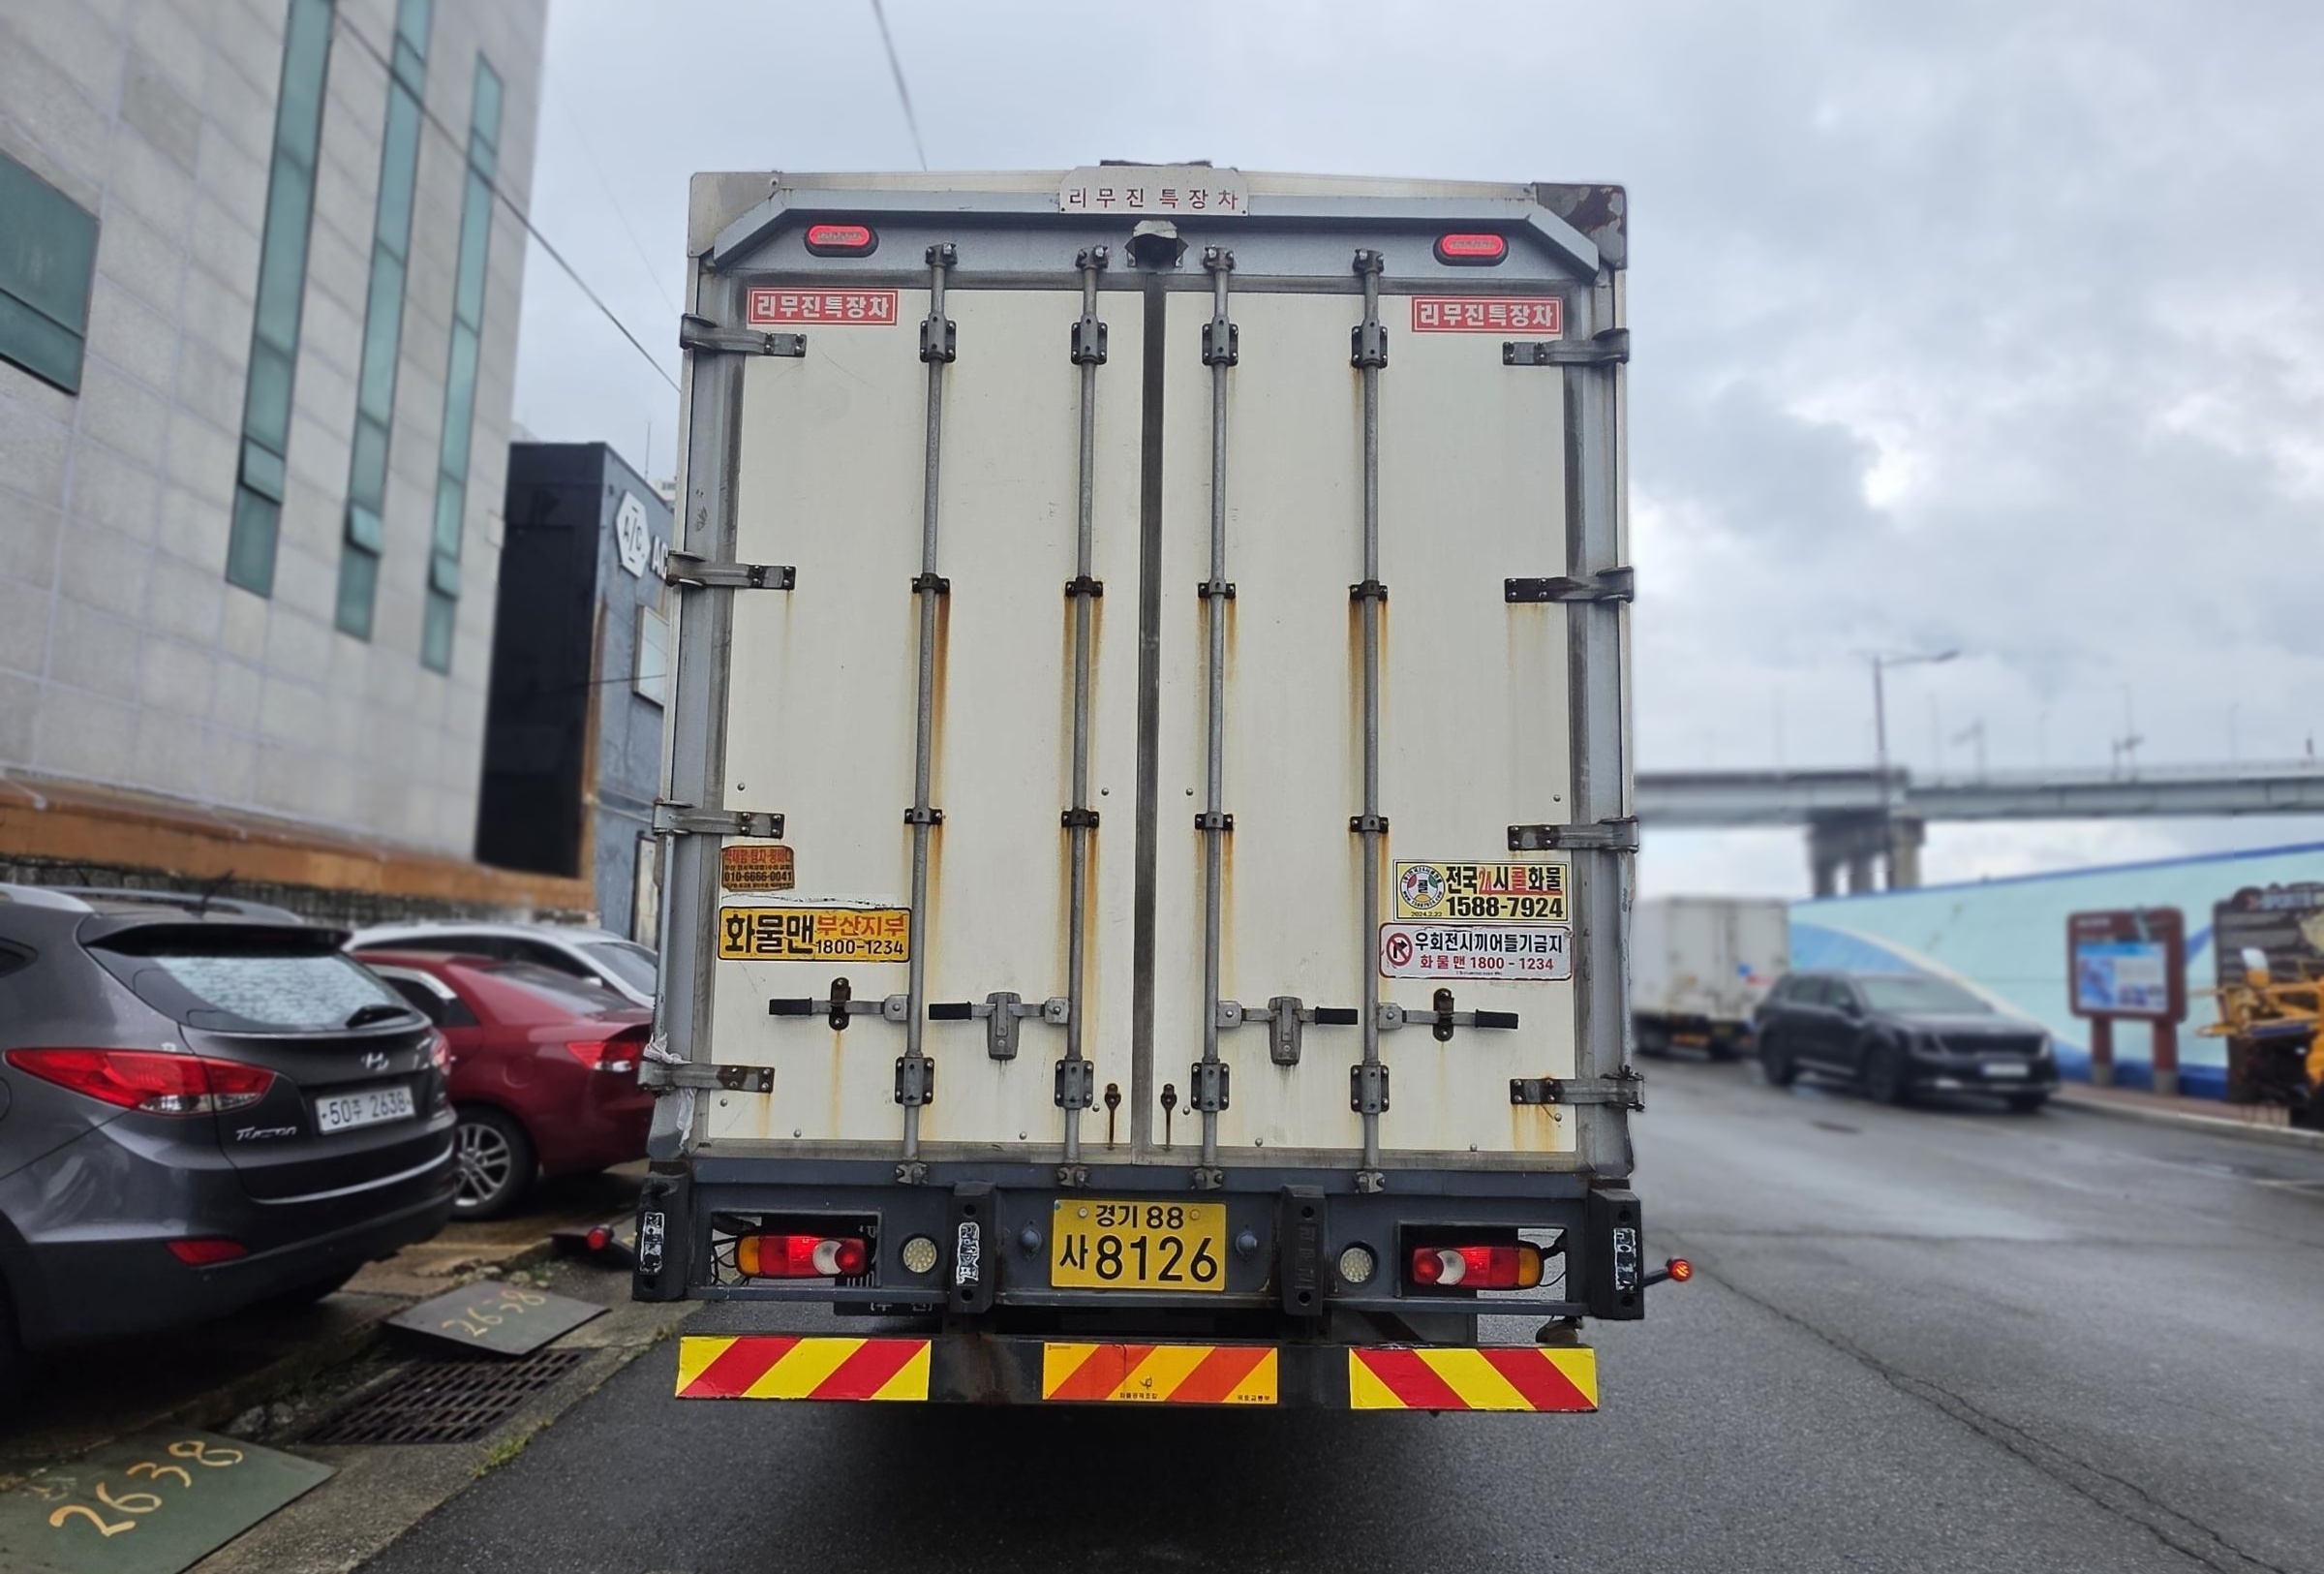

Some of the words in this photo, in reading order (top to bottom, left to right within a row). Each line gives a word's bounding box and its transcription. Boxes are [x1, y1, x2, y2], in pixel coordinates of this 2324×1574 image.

[756, 295, 889, 319] 리무진특장차
[1421, 303, 1553, 327] 리무진특장차
[1446, 896, 1564, 918] 1588-7924
[724, 913, 814, 954] 화물맨
[816, 914, 905, 938] 부산지부
[815, 939, 904, 955] 1800-1234
[369, 1090, 408, 1118] 2638
[1095, 1204, 1139, 1228] 경기
[1146, 1205, 1184, 1230] 88
[49, 1439, 243, 1537] 2638
